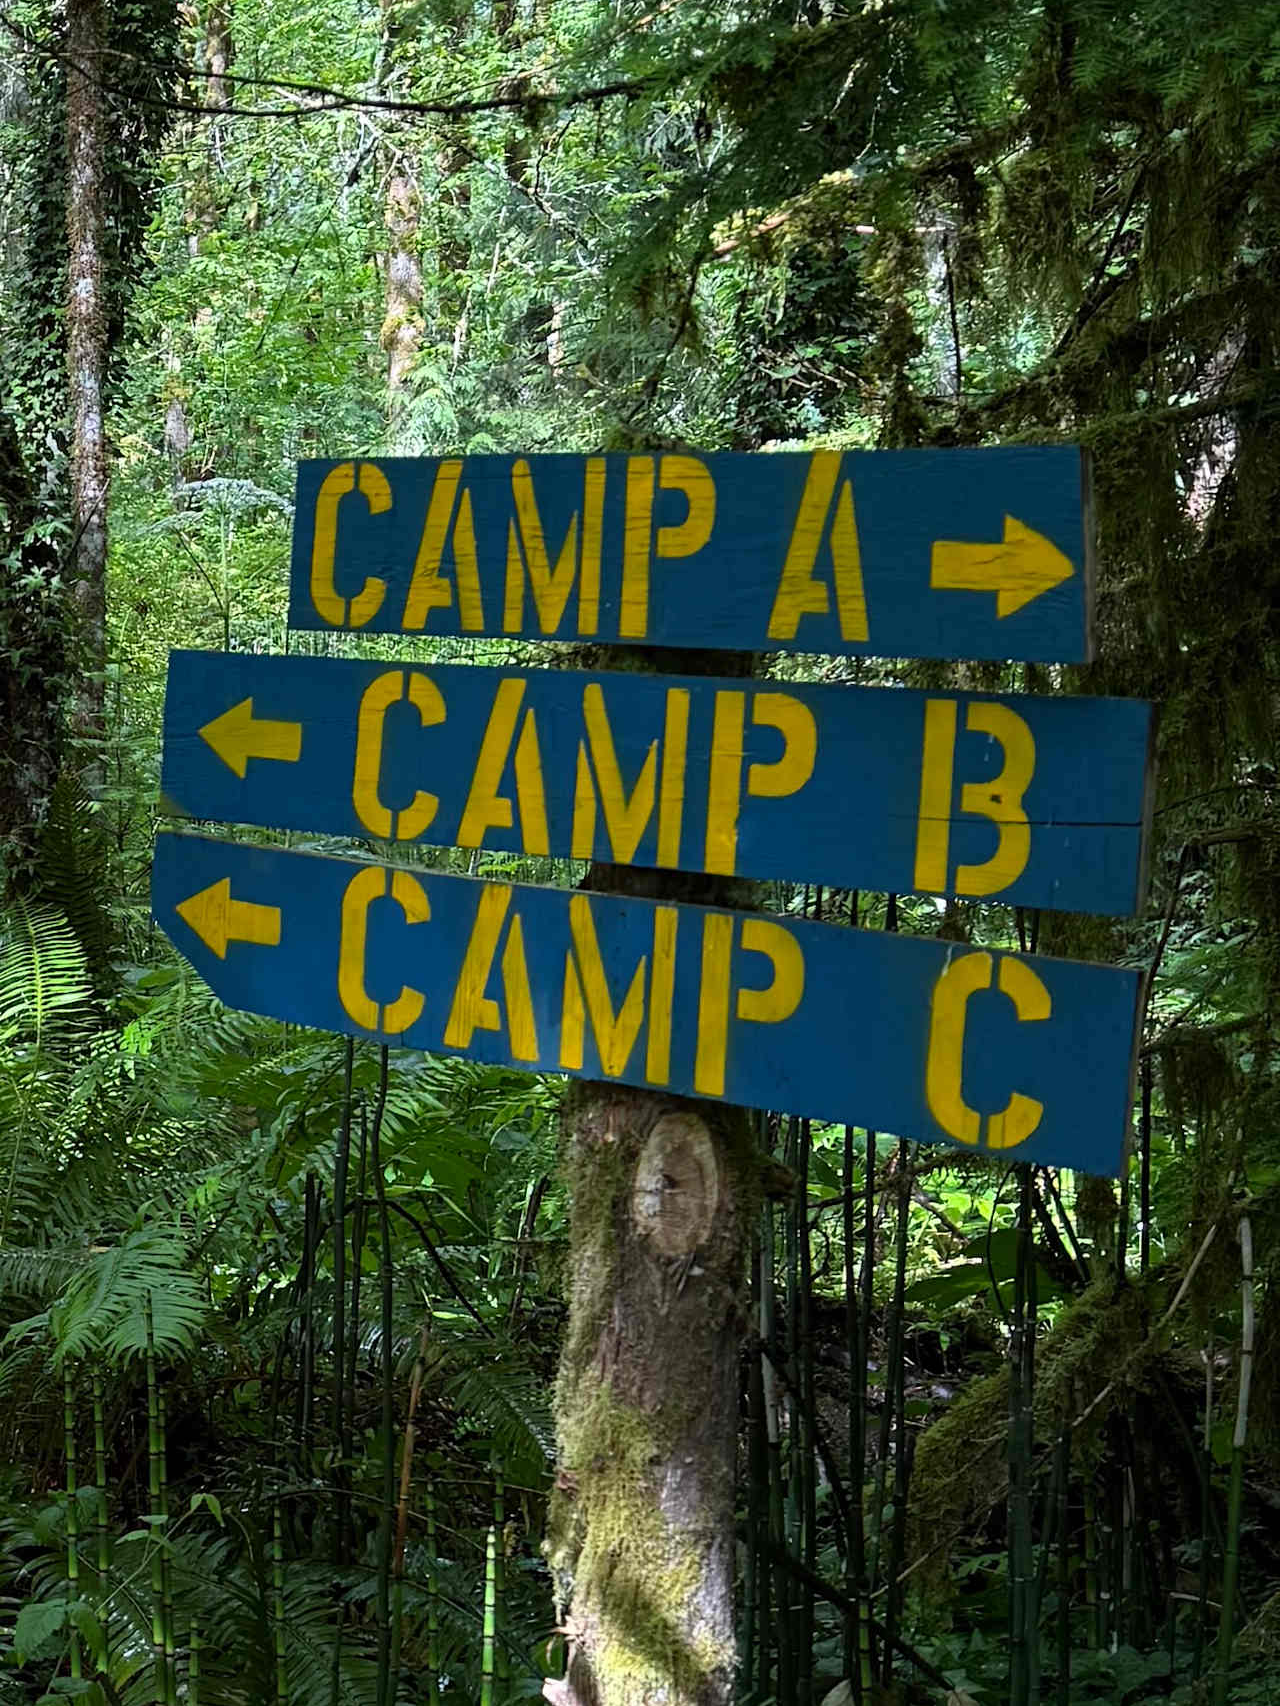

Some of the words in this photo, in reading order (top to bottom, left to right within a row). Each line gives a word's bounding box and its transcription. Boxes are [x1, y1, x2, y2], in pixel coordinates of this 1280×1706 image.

[310, 454, 716, 639] CAMP
[767, 450, 869, 642] A
[352, 670, 817, 877] CAMP
[913, 699, 1035, 897] B
[337, 865, 804, 1097] CAMP
[925, 951, 1053, 1150] C
